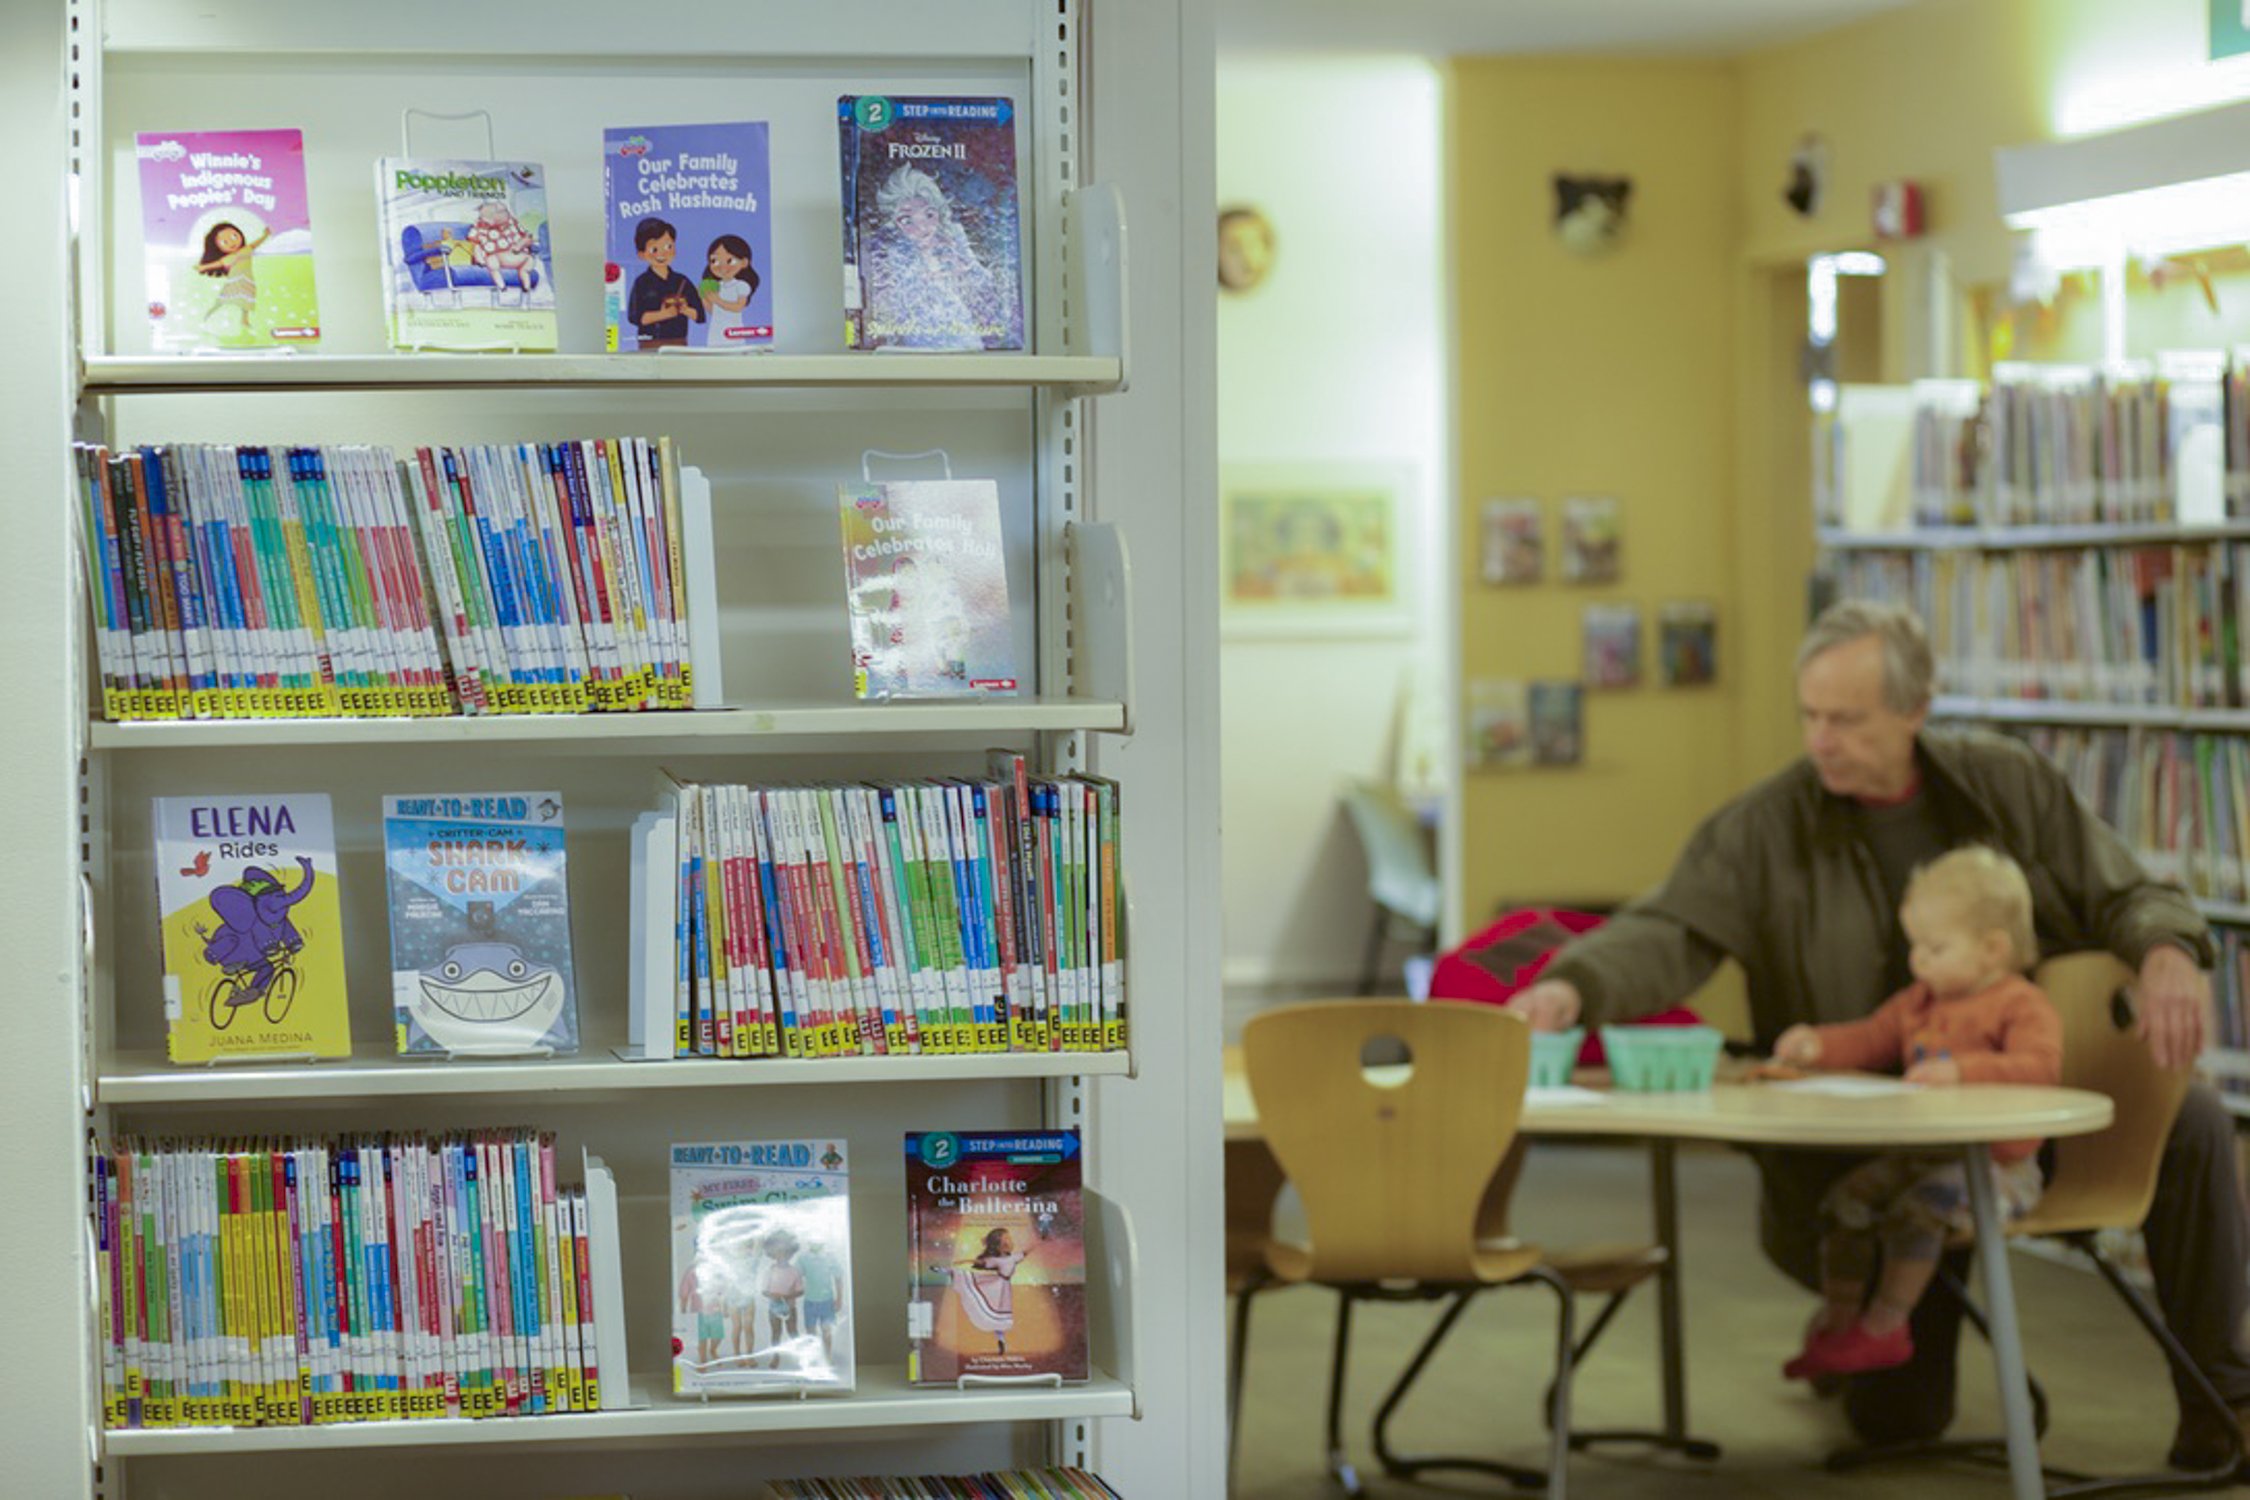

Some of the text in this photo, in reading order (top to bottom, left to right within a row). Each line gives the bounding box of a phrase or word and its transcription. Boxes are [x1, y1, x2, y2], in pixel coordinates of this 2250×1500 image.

[869, 104, 882, 122] 2
[903, 106, 928, 116] STEP
[948, 105, 998, 118] READING
[913, 132, 942, 144] Disney
[888, 143, 966, 160] FROZEN II
[190, 153, 262, 170] Winnie's
[638, 154, 738, 176] Our Family
[180, 172, 272, 190] Indigenous
[396, 170, 506, 195] Poppleton
[638, 175, 738, 194] Celebrates
[167, 188, 276, 212] Peoples' Day
[619, 192, 758, 218] Rosh Hashanah
[872, 512, 972, 535] Our Family
[854, 534, 955, 561] Celebrates
[682, 671, 690, 686] E
[561, 689, 571, 704] E
[615, 687, 625, 703] E
[625, 681, 635, 697] E
[657, 684, 666, 699] E
[668, 686, 676, 700] E
[143, 696, 152, 711] E
[156, 697, 165, 712] E
[198, 698, 208, 712] E
[210, 695, 218, 710] E
[274, 695, 282, 710] E
[285, 696, 294, 710] E
[308, 694, 317, 709] E
[340, 694, 350, 710] E
[363, 694, 373, 710] E
[383, 694, 391, 709] E
[408, 693, 417, 708] E
[429, 692, 439, 708] E
[517, 690, 526, 705] E
[530, 691, 538, 706] E
[574, 690, 583, 705] E
[119, 698, 127, 713] E
[190, 805, 296, 838] ELENA
[489, 828, 514, 837] CAM
[220, 840, 279, 859] Rides
[428, 840, 527, 867] SHARK
[446, 868, 520, 894] CAM
[1052, 1015, 1060, 1031] E
[208, 1032, 314, 1048] JUANA MEDINA
[680, 1026, 688, 1041] E
[752, 1031, 760, 1046] E
[921, 1031, 930, 1047] E
[944, 1030, 952, 1046] E
[978, 1030, 986, 1045] E
[998, 1025, 1007, 1043] E
[1037, 1030, 1046, 1046] E
[1071, 1028, 1079, 1044] E
[1083, 1029, 1091, 1043] E
[1108, 1028, 1115, 1043] E
[738, 1034, 746, 1049] E
[789, 1034, 798, 1049] E
[804, 1036, 813, 1050] E
[936, 1139, 950, 1159] 2
[970, 1140, 996, 1152] STEP
[1015, 1138, 1064, 1151] READING
[702, 1183, 721, 1194] MY
[927, 1176, 1028, 1194] Charlotte
[938, 1196, 1058, 1214] the Ballerina
[302, 1375, 309, 1390] E
[558, 1373, 565, 1388] E
[588, 1385, 596, 1400] E
[257, 1396, 264, 1412] E
[326, 1400, 334, 1415] E
[336, 1399, 344, 1413] E
[355, 1398, 364, 1413] E
[377, 1397, 385, 1412] E
[391, 1398, 398, 1413] E
[436, 1394, 445, 1409] E
[474, 1394, 482, 1408] E
[484, 1394, 492, 1408] E
[105, 1406, 114, 1422] E
[145, 1405, 151, 1419] E
[153, 1405, 163, 1420] E
[190, 1405, 198, 1420] E
[201, 1405, 209, 1420] E
[223, 1403, 231, 1417] E
[232, 1404, 241, 1420] E
[267, 1404, 275, 1419] E
[289, 1402, 298, 1417] E
